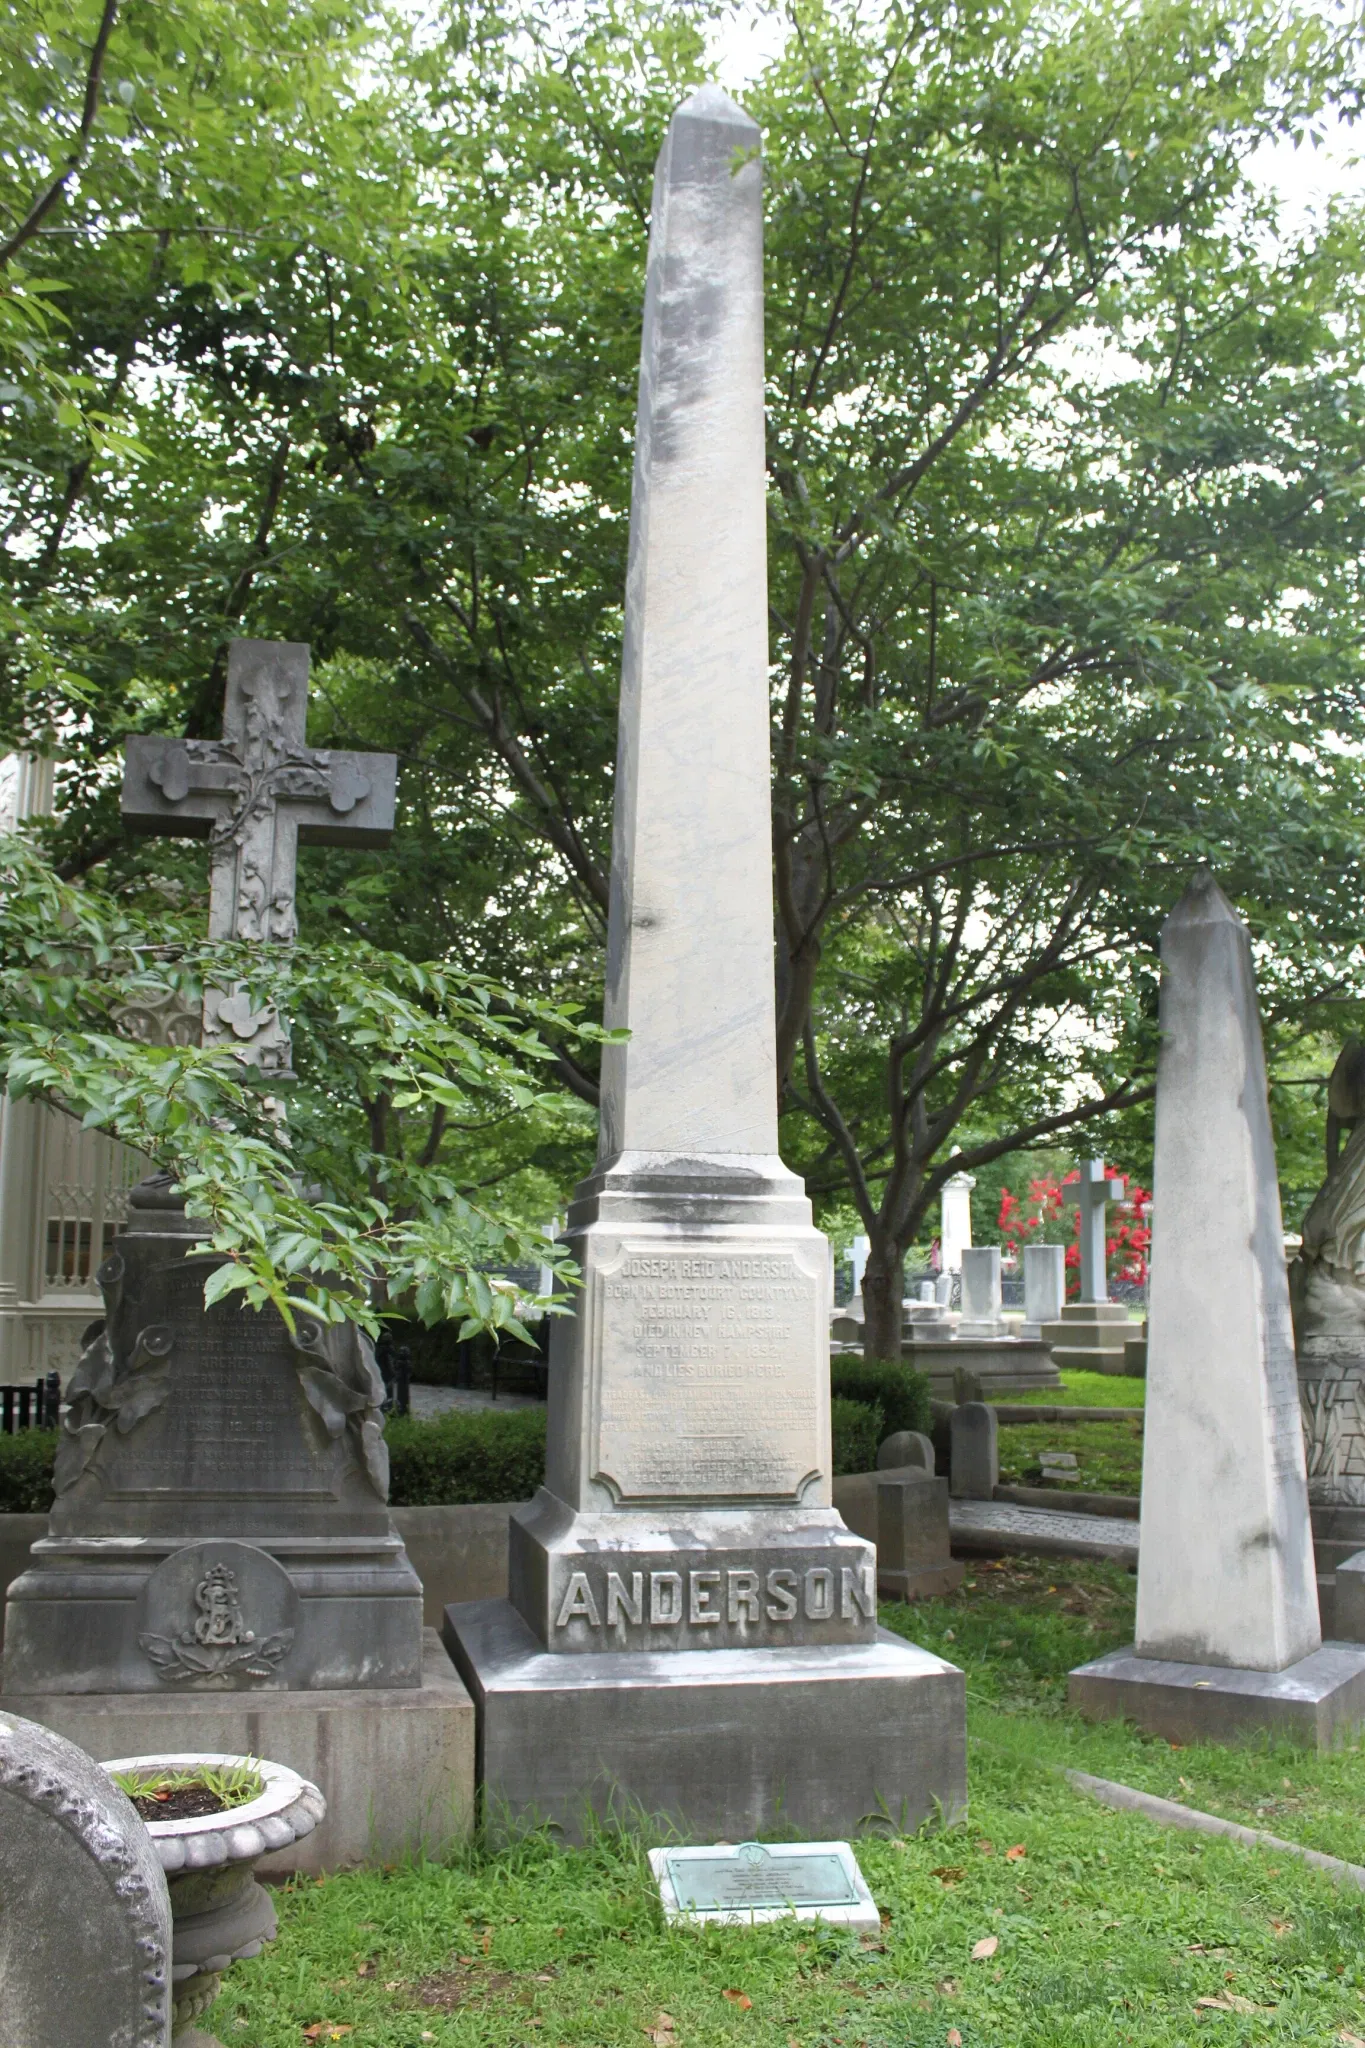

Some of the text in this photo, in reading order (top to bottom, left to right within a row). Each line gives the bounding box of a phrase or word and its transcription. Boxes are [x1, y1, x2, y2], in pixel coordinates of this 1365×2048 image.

[621, 1259, 677, 1279] JOSEPH
[681, 1260, 716, 1279] REID
[605, 1284, 639, 1300] BORN
[643, 1284, 655, 1300] IN
[658, 1285, 734, 1301] BOTETOURT
[641, 1304, 712, 1320] FEBRUARY
[633, 1323, 792, 1340] DIED IN NEW HAMPSHIRE
[636, 1344, 717, 1359] SEPTEMBER
[666, 1364, 695, 1378] LIES
[697, 1364, 748, 1378] BURIED
[555, 1566, 875, 1627] ANDERSON
